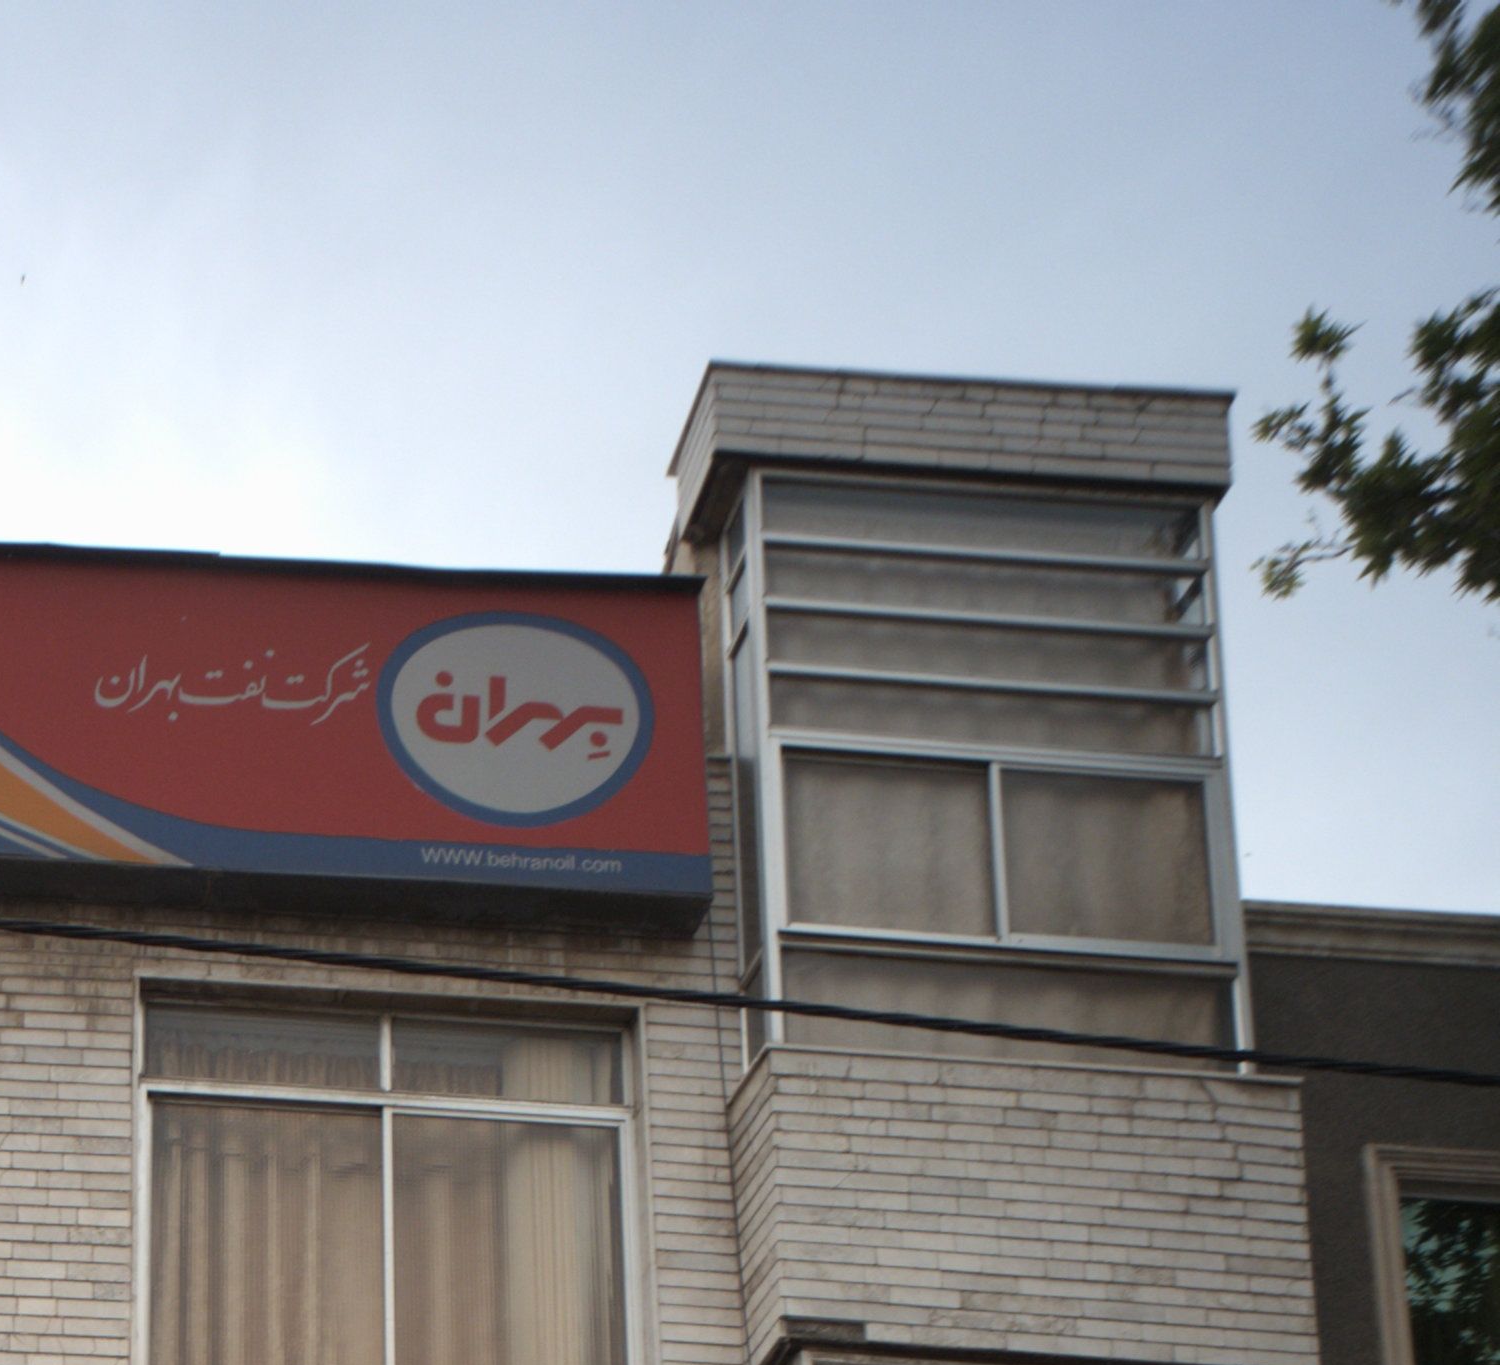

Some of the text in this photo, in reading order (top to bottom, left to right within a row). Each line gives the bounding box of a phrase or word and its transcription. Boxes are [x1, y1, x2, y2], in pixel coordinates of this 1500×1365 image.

[94, 642, 370, 726] شرکت نفت بهران
[414, 669, 625, 762] بهران
